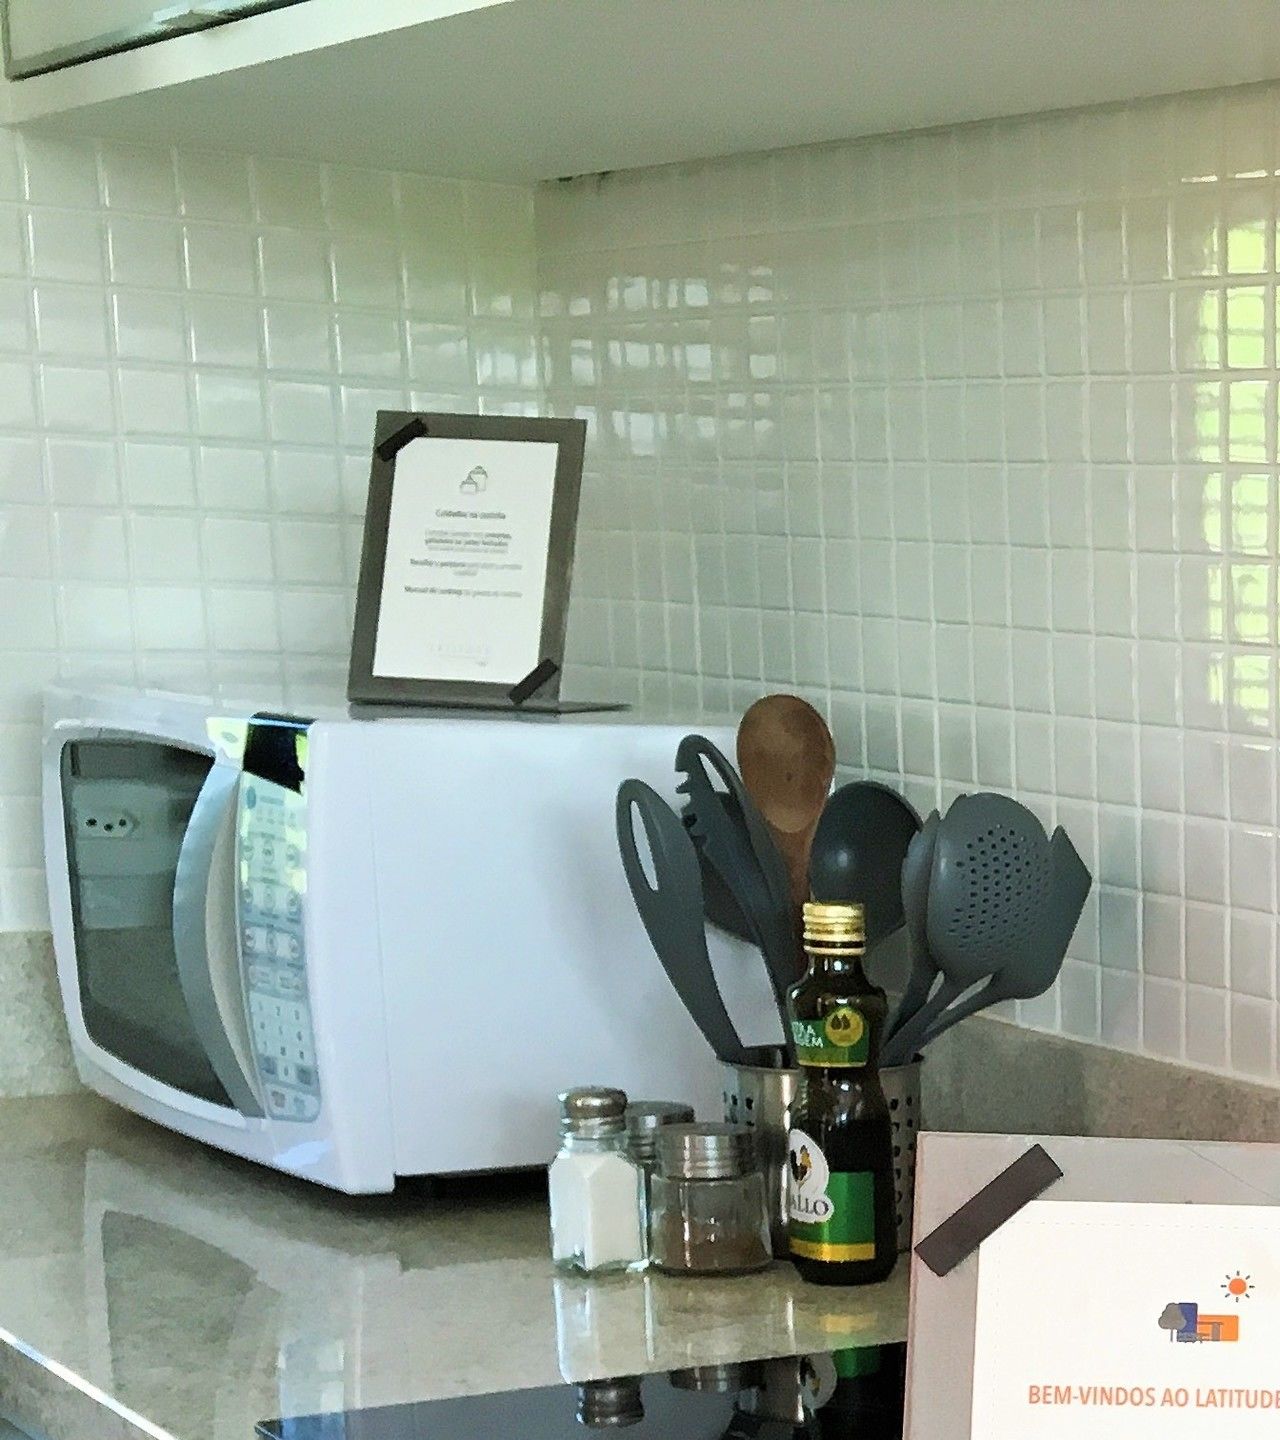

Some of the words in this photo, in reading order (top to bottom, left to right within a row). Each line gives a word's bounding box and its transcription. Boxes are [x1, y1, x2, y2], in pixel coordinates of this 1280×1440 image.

[789, 1194, 829, 1216] ALLO
[1028, 1385, 1155, 1406] BEM-VINDOS
[1161, 1387, 1188, 1407] AO
